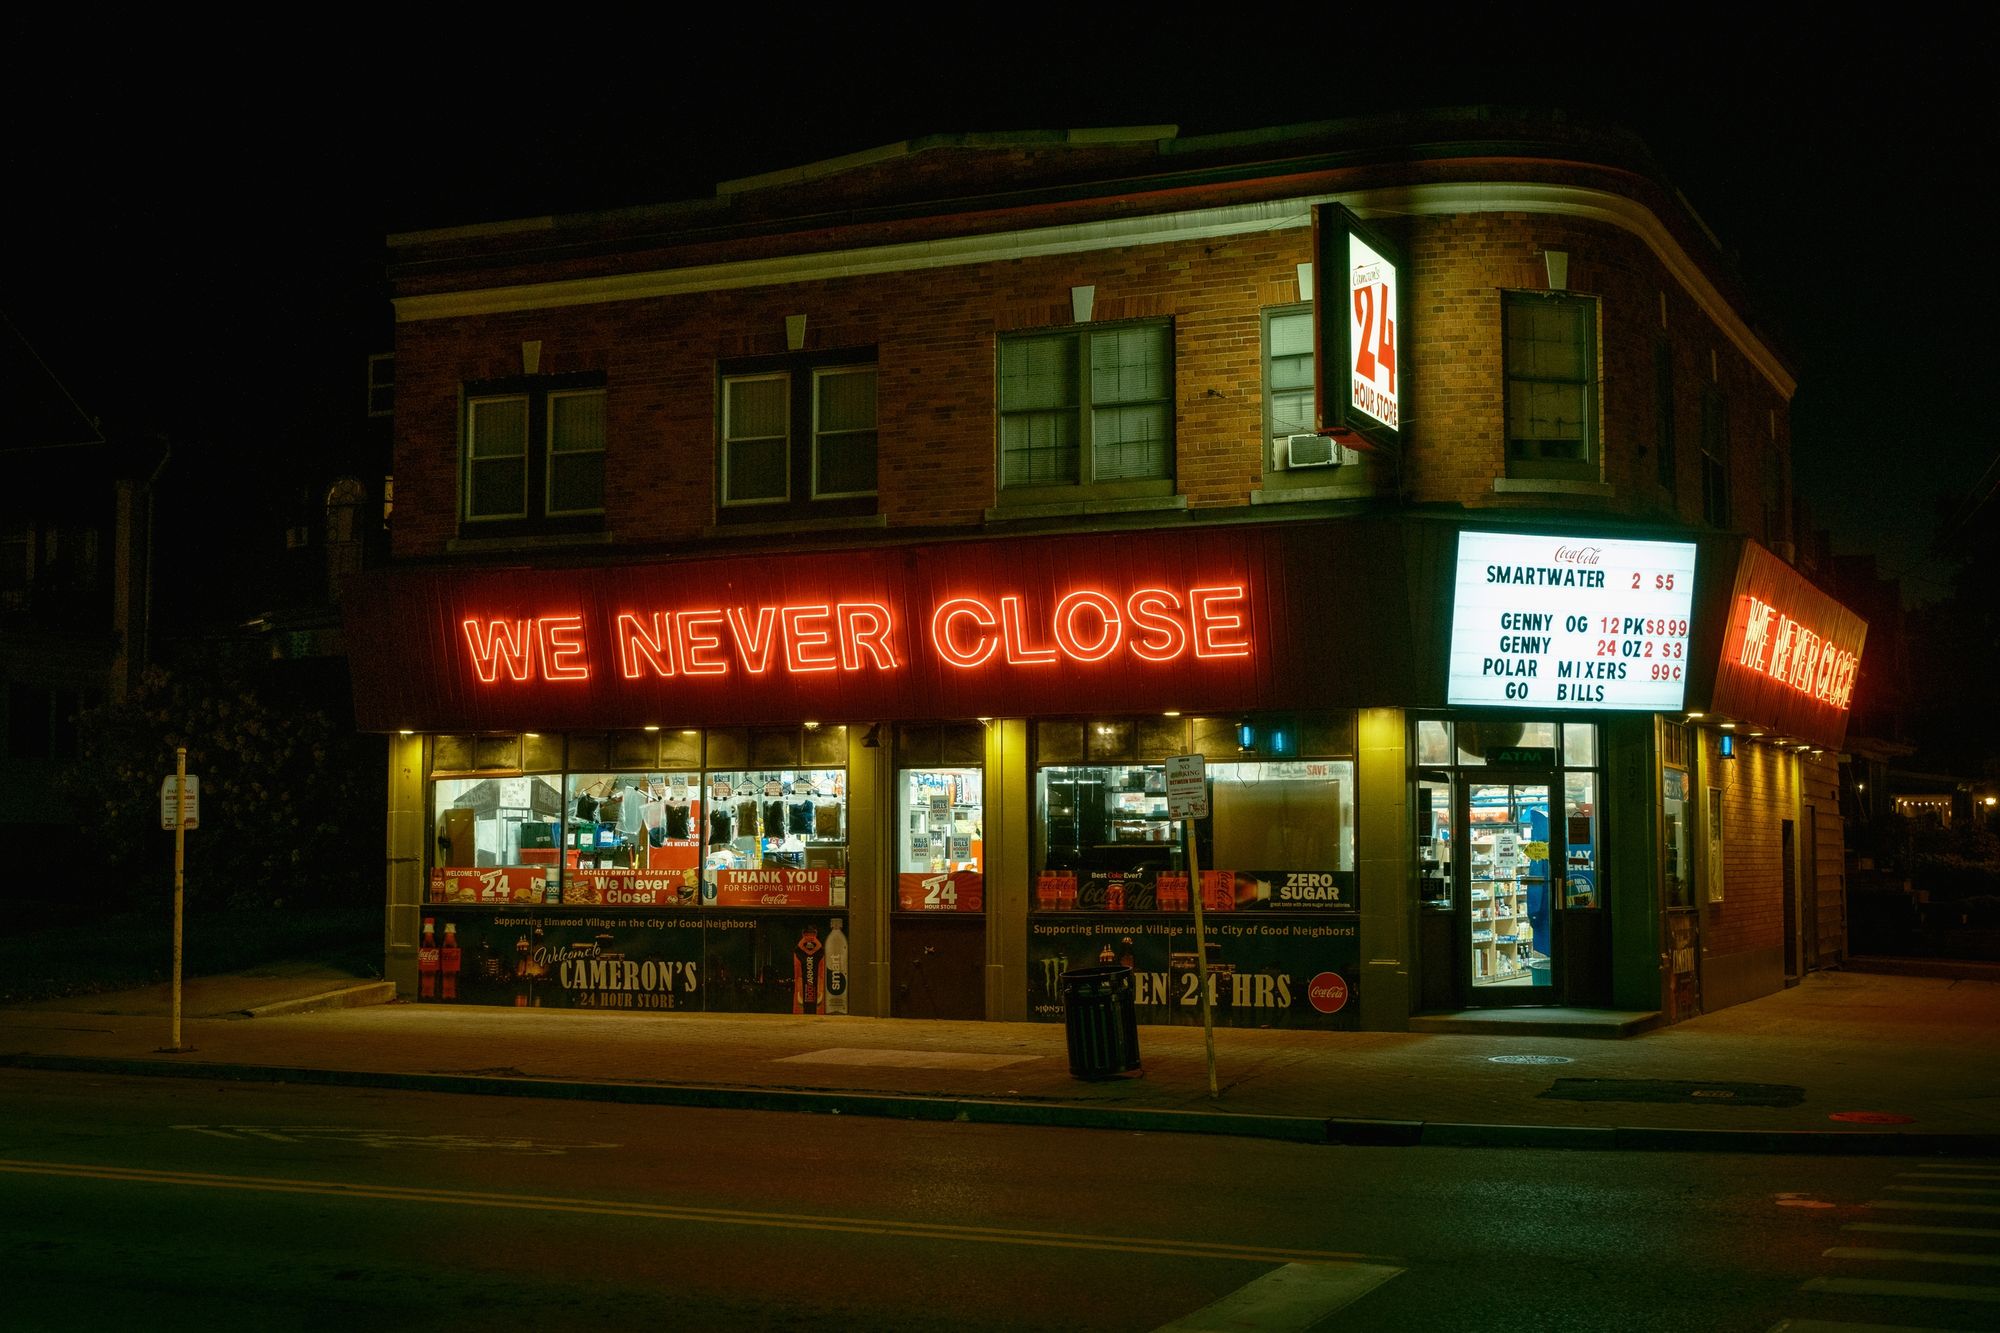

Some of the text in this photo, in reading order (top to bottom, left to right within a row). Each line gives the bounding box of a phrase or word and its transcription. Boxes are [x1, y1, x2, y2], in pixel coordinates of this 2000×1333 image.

[1354, 283, 1395, 395] 24
[1354, 379, 1397, 427] HOUR STORE
[1486, 565, 1674, 591] SMARTWATER 2 $5
[463, 586, 1249, 683] WE NEVER CLOSE
[1501, 612, 1553, 632] GENNY
[1566, 615, 1588, 633] OG
[1600, 617, 1619, 634] 12
[1624, 618, 1644, 636] PK
[1500, 636, 1551, 654] GENNY
[1597, 640, 1616, 657] 24
[1622, 640, 1642, 658] OZ
[1644, 641, 1653, 658] 2
[1740, 596, 1858, 710] WE NEVER CLOSE
[1483, 658, 1682, 680] POLAR MIXERS 99¢
[1505, 682, 1604, 702] GO BILLS
[1170, 770, 1200, 778] KING
[1306, 765, 1328, 776] SAVE
[481, 875, 510, 898] 24
[594, 877, 670, 890] We Never
[729, 872, 818, 883] THANK YOU
[1286, 874, 1332, 886] ZERO
[607, 890, 656, 903] Close!
[925, 880, 957, 904] 24
[1280, 887, 1339, 900] SUGAR
[494, 917, 757, 930] Supporting Elmwood Village in the City of Good Neighbors!
[1034, 924, 1355, 937] Supporting Elmwood Village in he City of Good Neighbors!
[534, 941, 601, 967] Welcome to
[560, 960, 698, 992] CAMERON'S
[831, 954, 840, 990] smart
[580, 992, 675, 1008] 24 HOUR STORE
[1134, 972, 1168, 1005] EN
[1232, 973, 1291, 1008] HRS
[1035, 1004, 1064, 1012] MONST
